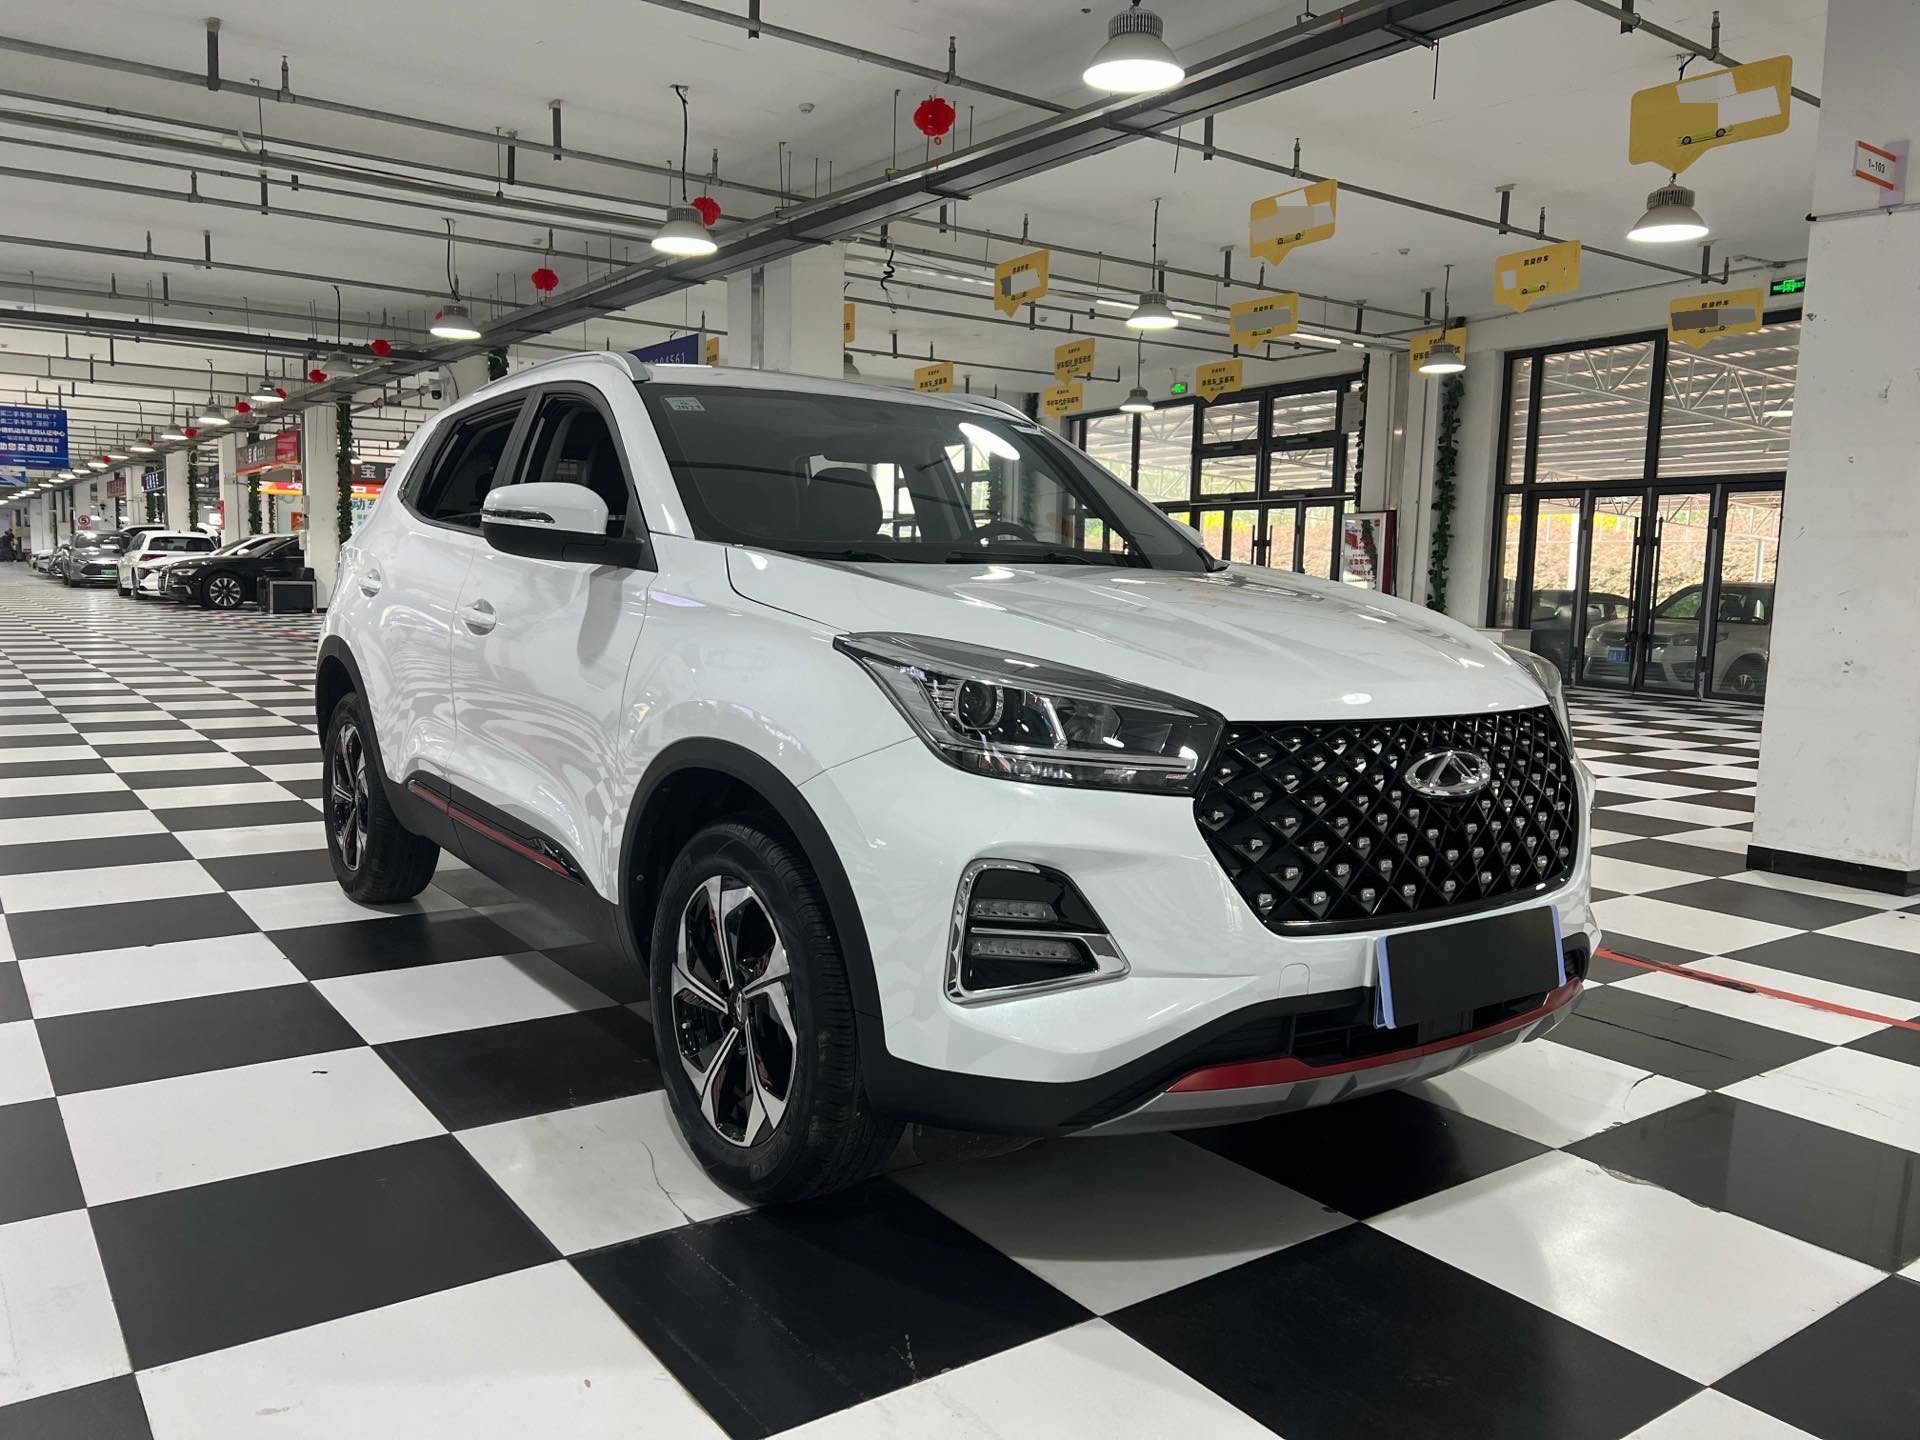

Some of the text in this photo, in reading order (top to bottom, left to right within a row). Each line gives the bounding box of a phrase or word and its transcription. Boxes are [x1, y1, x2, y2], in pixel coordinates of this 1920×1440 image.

[0, 427, 65, 437] 机动车检测认证中心
